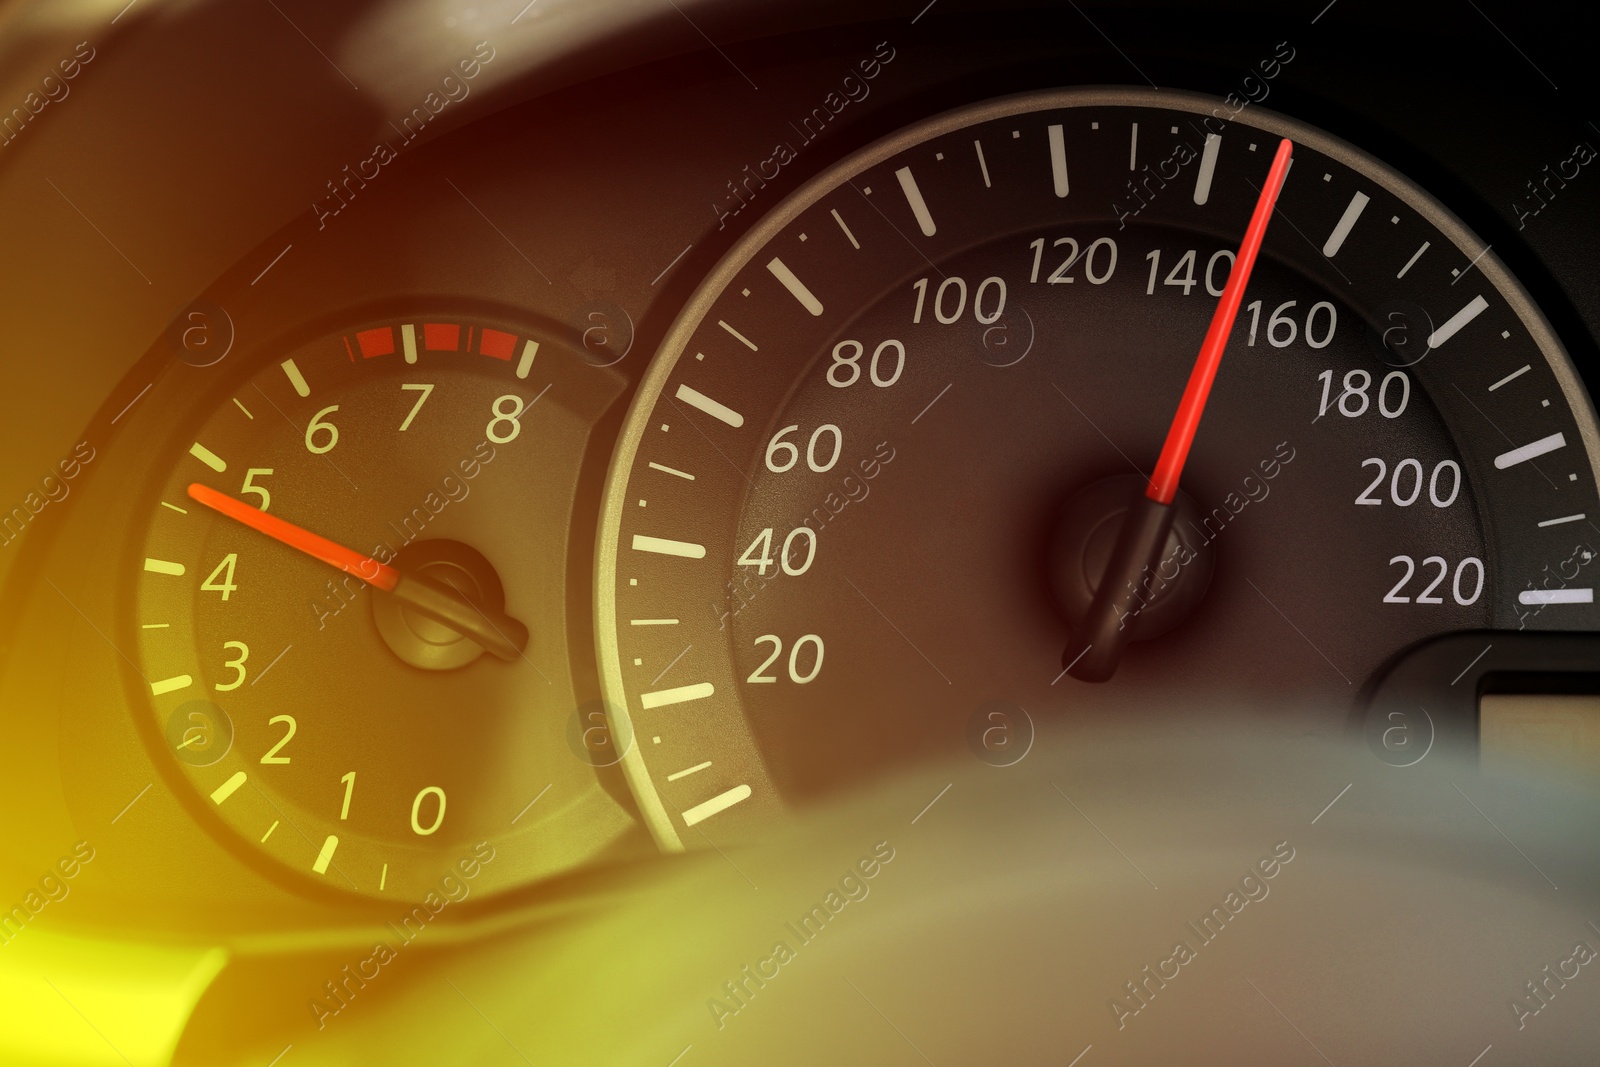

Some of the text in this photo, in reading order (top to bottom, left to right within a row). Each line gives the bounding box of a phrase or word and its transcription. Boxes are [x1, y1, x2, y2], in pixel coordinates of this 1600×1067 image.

[1030, 238, 1118, 285] 120
[1145, 249, 1237, 298] 140
[914, 276, 1007, 325] 100
[1246, 300, 1338, 349] 160
[826, 340, 906, 388] 80
[399, 384, 434, 431] 7
[1317, 369, 1411, 419] 180
[306, 405, 340, 454] 6
[486, 395, 524, 443] 8
[765, 424, 843, 473] 60
[241, 468, 274, 512] 5
[1355, 458, 1461, 508] 200
[737, 527, 817, 577] 40
[201, 553, 238, 601] 4
[1383, 555, 1485, 606] 220
[215, 641, 249, 691] 3
[746, 634, 825, 684] 20
[260, 715, 297, 764] 2
[341, 772, 355, 819] 1
[411, 786, 446, 835] 0
